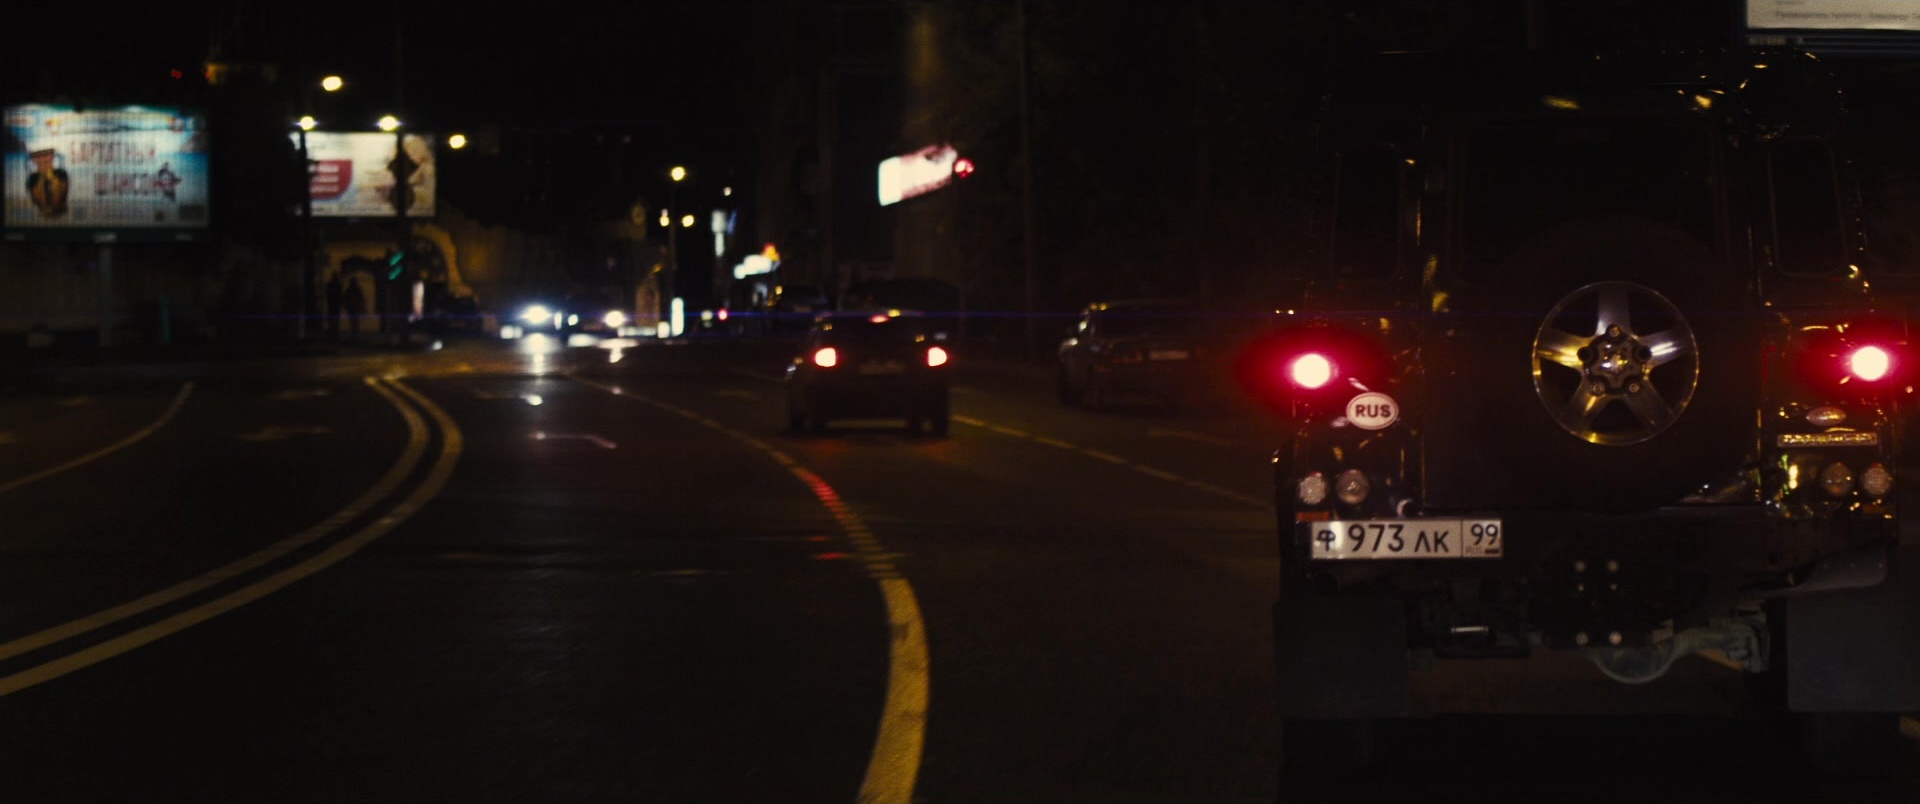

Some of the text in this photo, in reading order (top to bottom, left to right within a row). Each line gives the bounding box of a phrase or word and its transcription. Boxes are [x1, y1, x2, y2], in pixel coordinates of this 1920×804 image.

[1355, 404, 1392, 418] RUS
[1347, 523, 1406, 553] 973
[1470, 523, 1500, 546] 99
